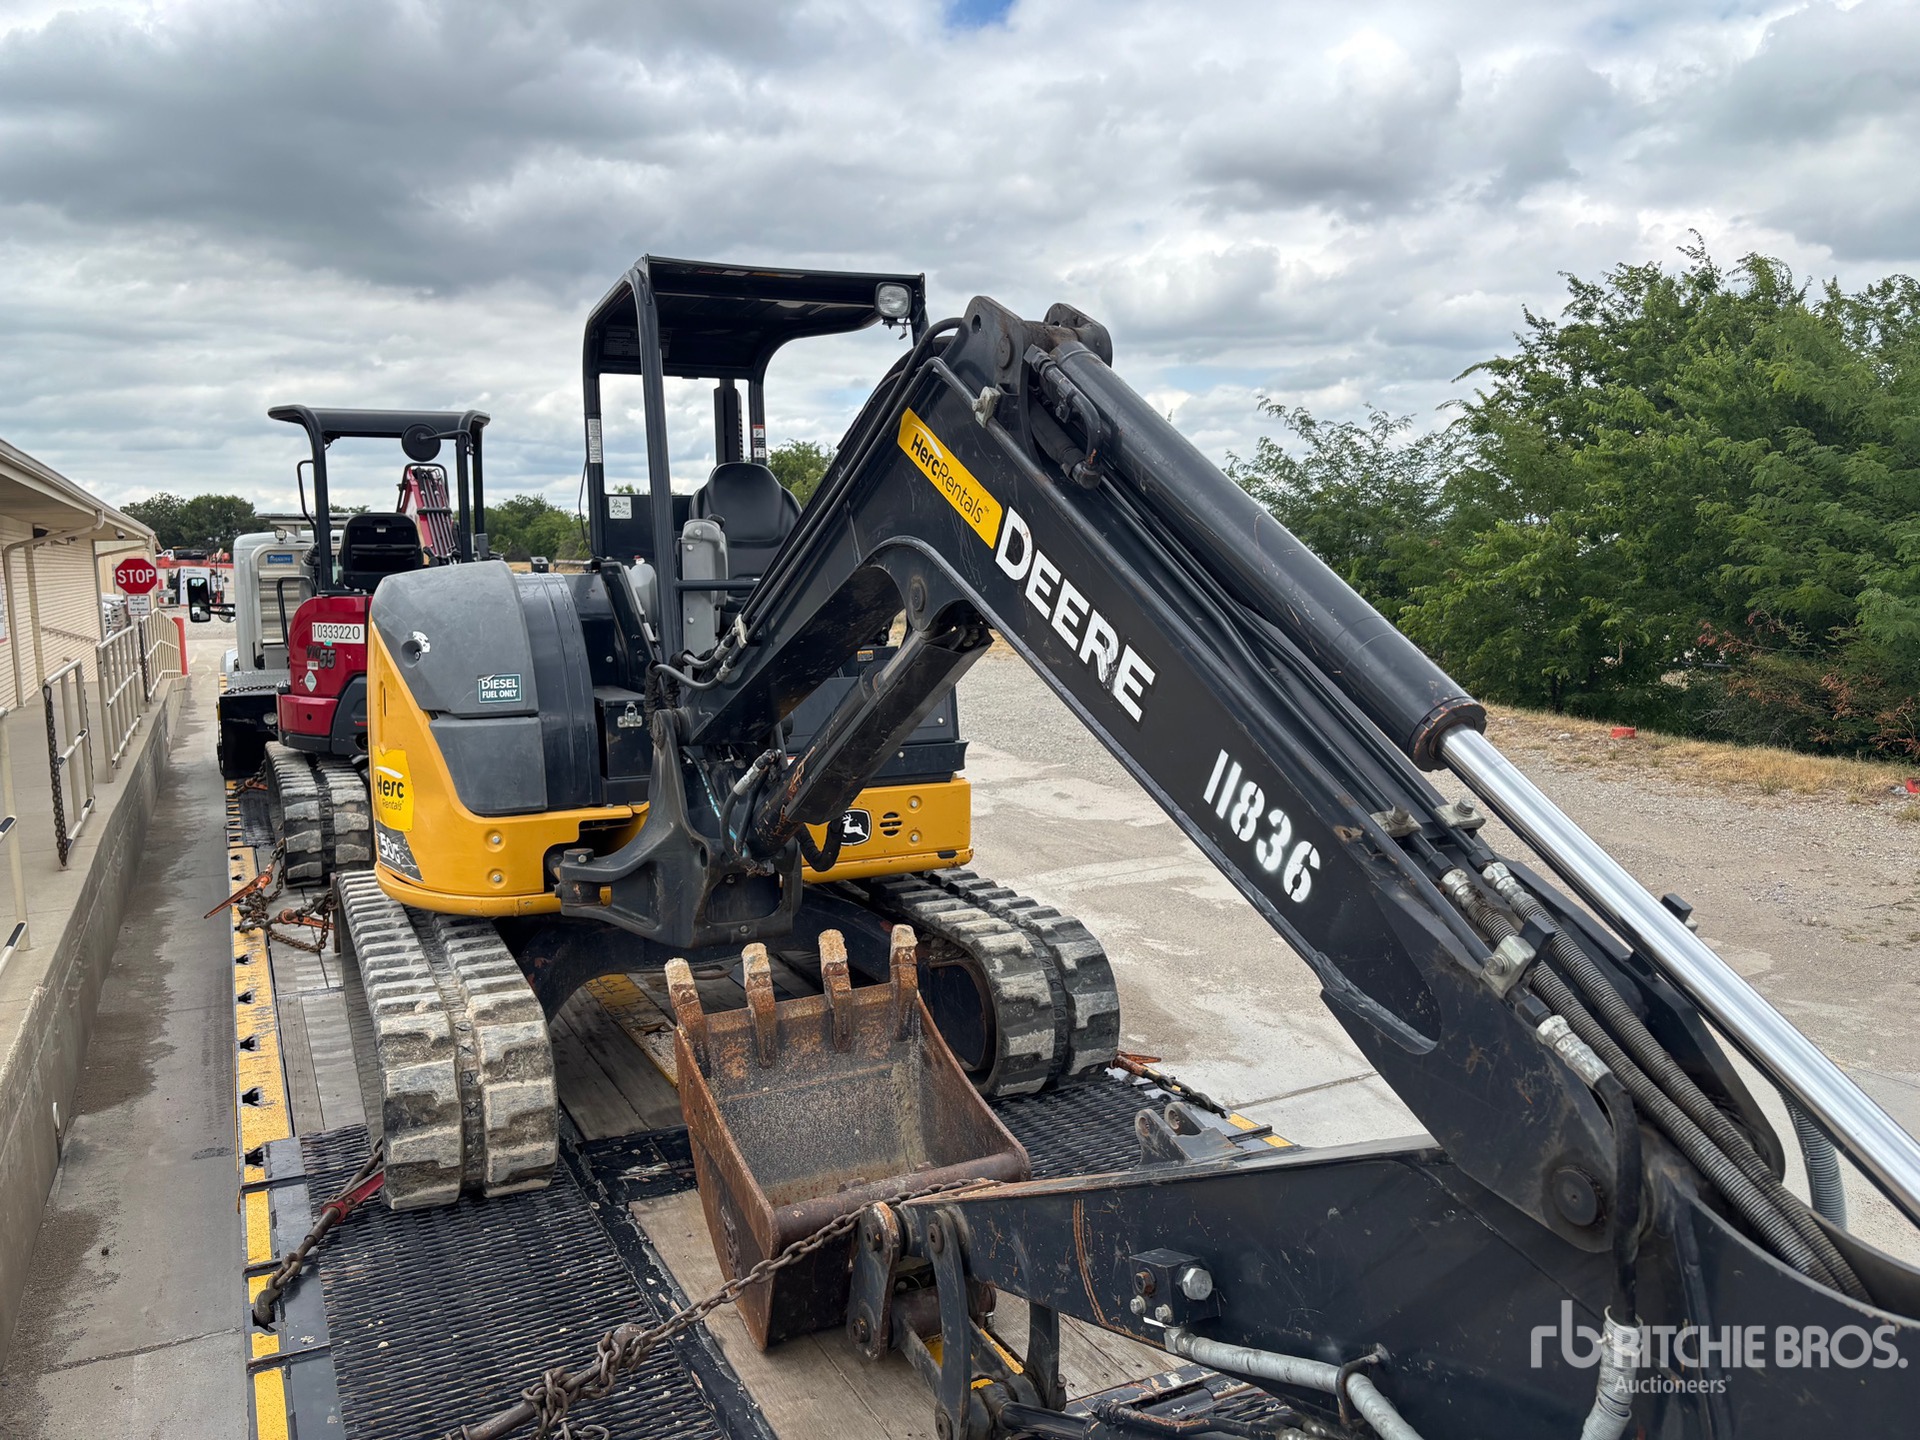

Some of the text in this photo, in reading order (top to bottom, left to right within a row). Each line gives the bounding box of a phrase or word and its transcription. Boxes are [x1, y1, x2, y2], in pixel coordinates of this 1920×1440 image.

[117, 569, 155, 584] STOP
[995, 506, 1156, 723] DEERE
[312, 624, 361, 640] 10333220
[481, 679, 518, 690] DIESEL
[482, 689, 517, 699] FUEL ONLY
[377, 774, 404, 799] Herc
[1203, 749, 1321, 903] 11836
